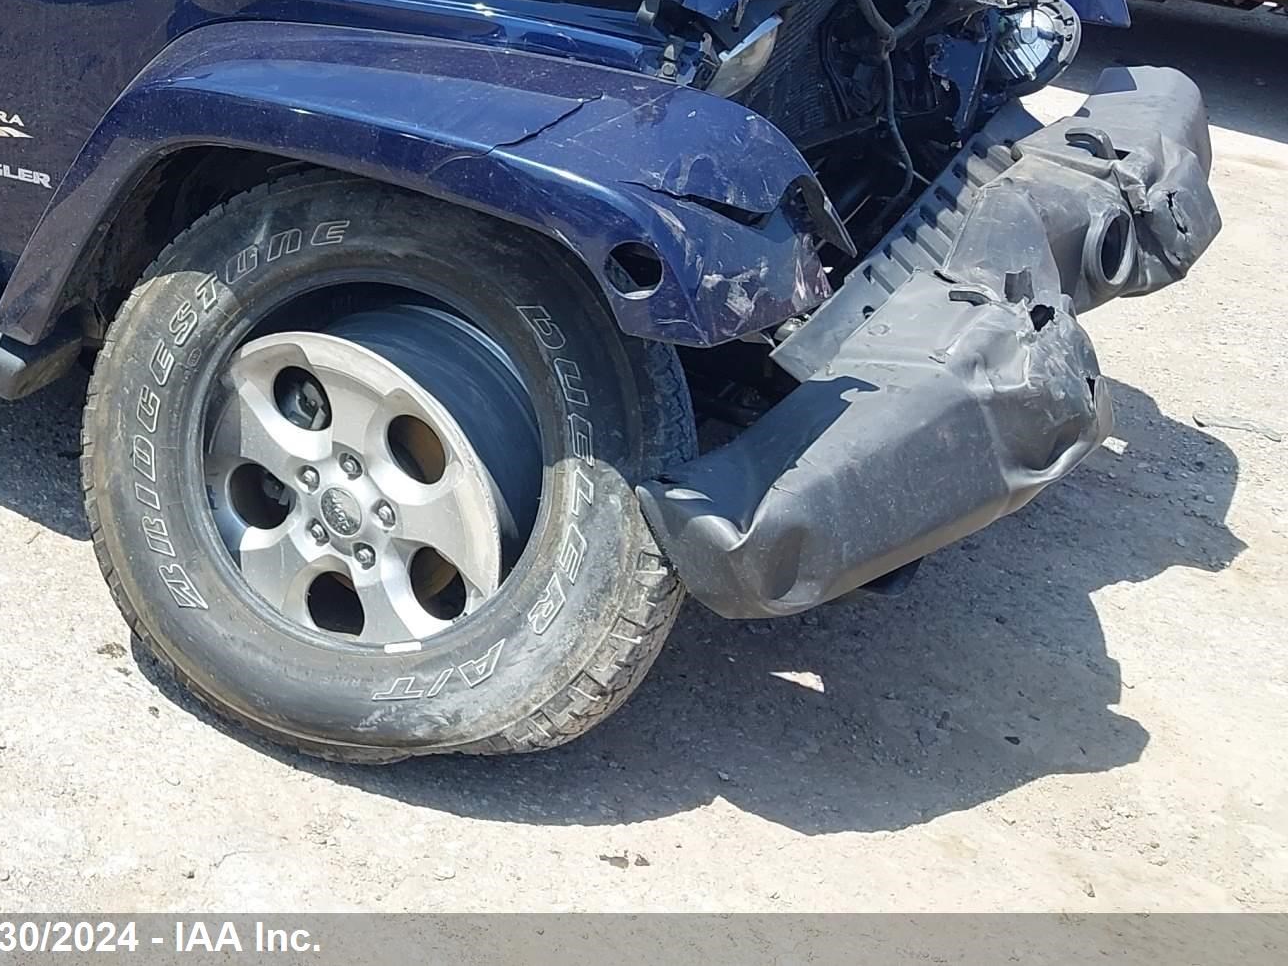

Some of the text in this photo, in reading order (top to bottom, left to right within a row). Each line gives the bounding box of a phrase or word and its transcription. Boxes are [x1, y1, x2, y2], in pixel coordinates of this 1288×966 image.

[128, 219, 352, 611] BRIDGESTONE
[372, 304, 595, 702] DUELER A/T
